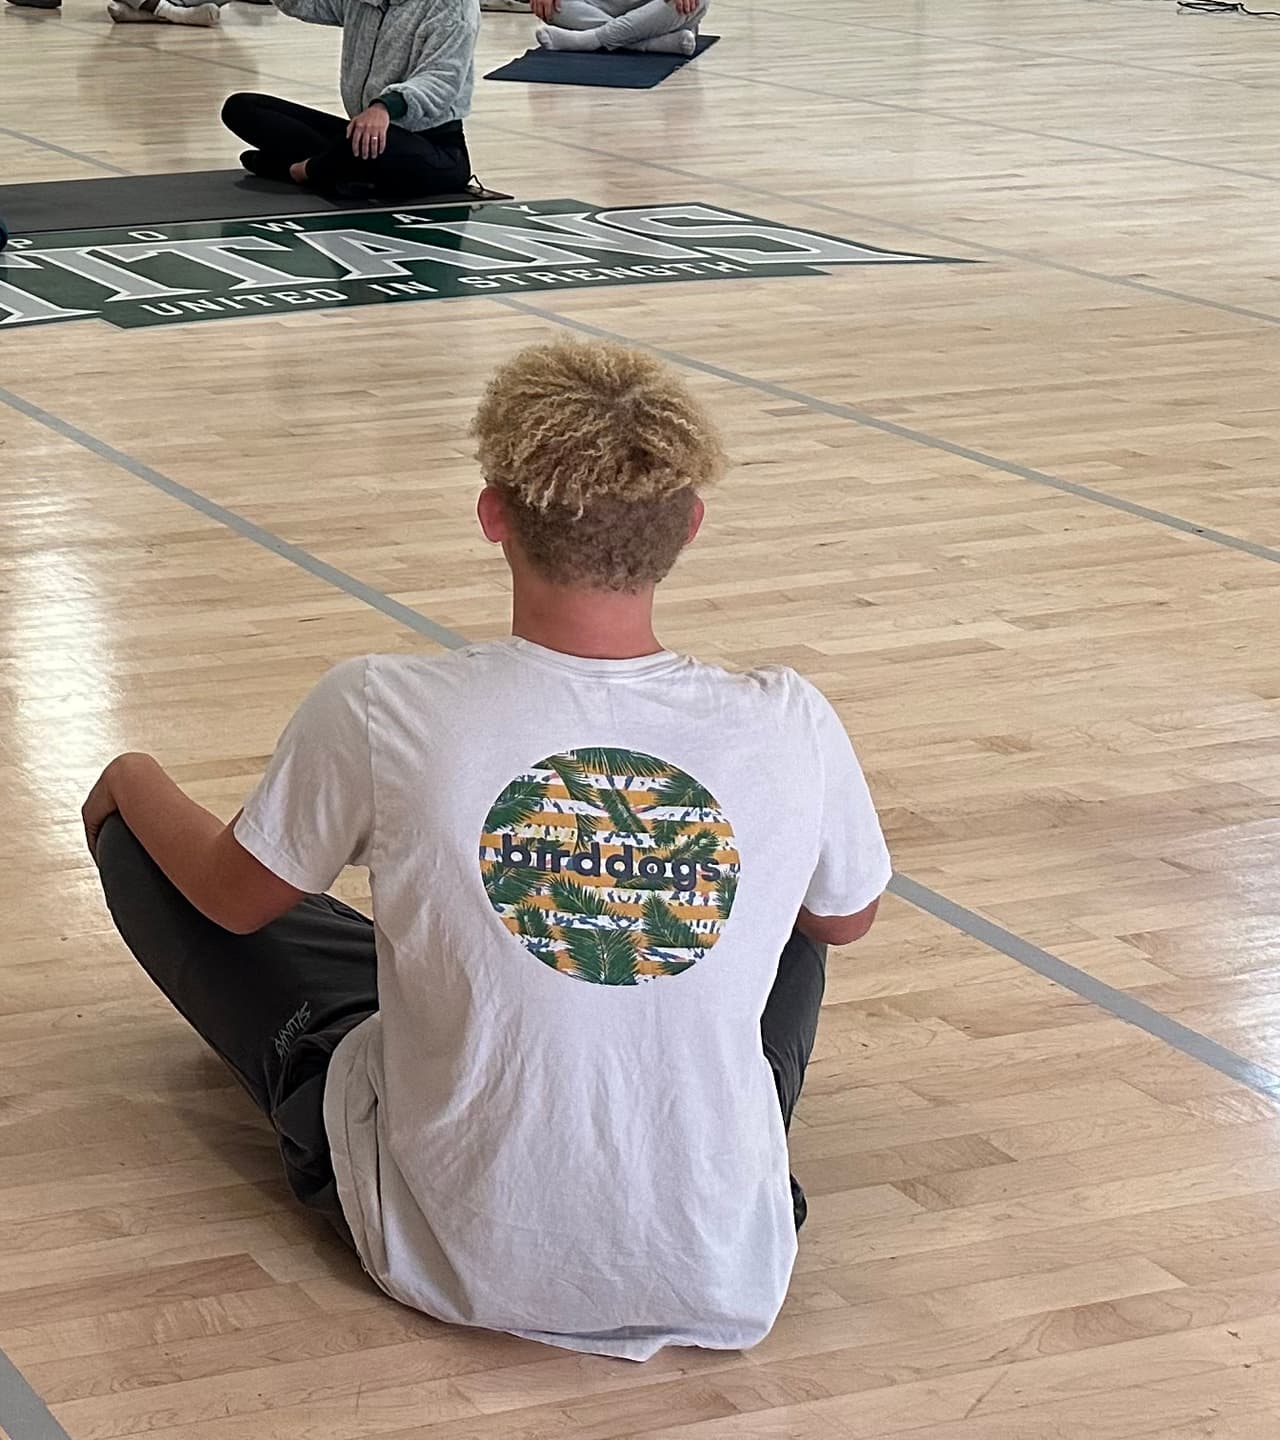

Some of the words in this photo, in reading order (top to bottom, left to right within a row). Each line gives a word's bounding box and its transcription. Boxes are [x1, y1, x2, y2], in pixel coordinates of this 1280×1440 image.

[141, 287, 349, 317] UNITED
[370, 280, 439, 296] IN
[458, 261, 753, 289] STRENGTH
[501, 833, 721, 893] birddogs
